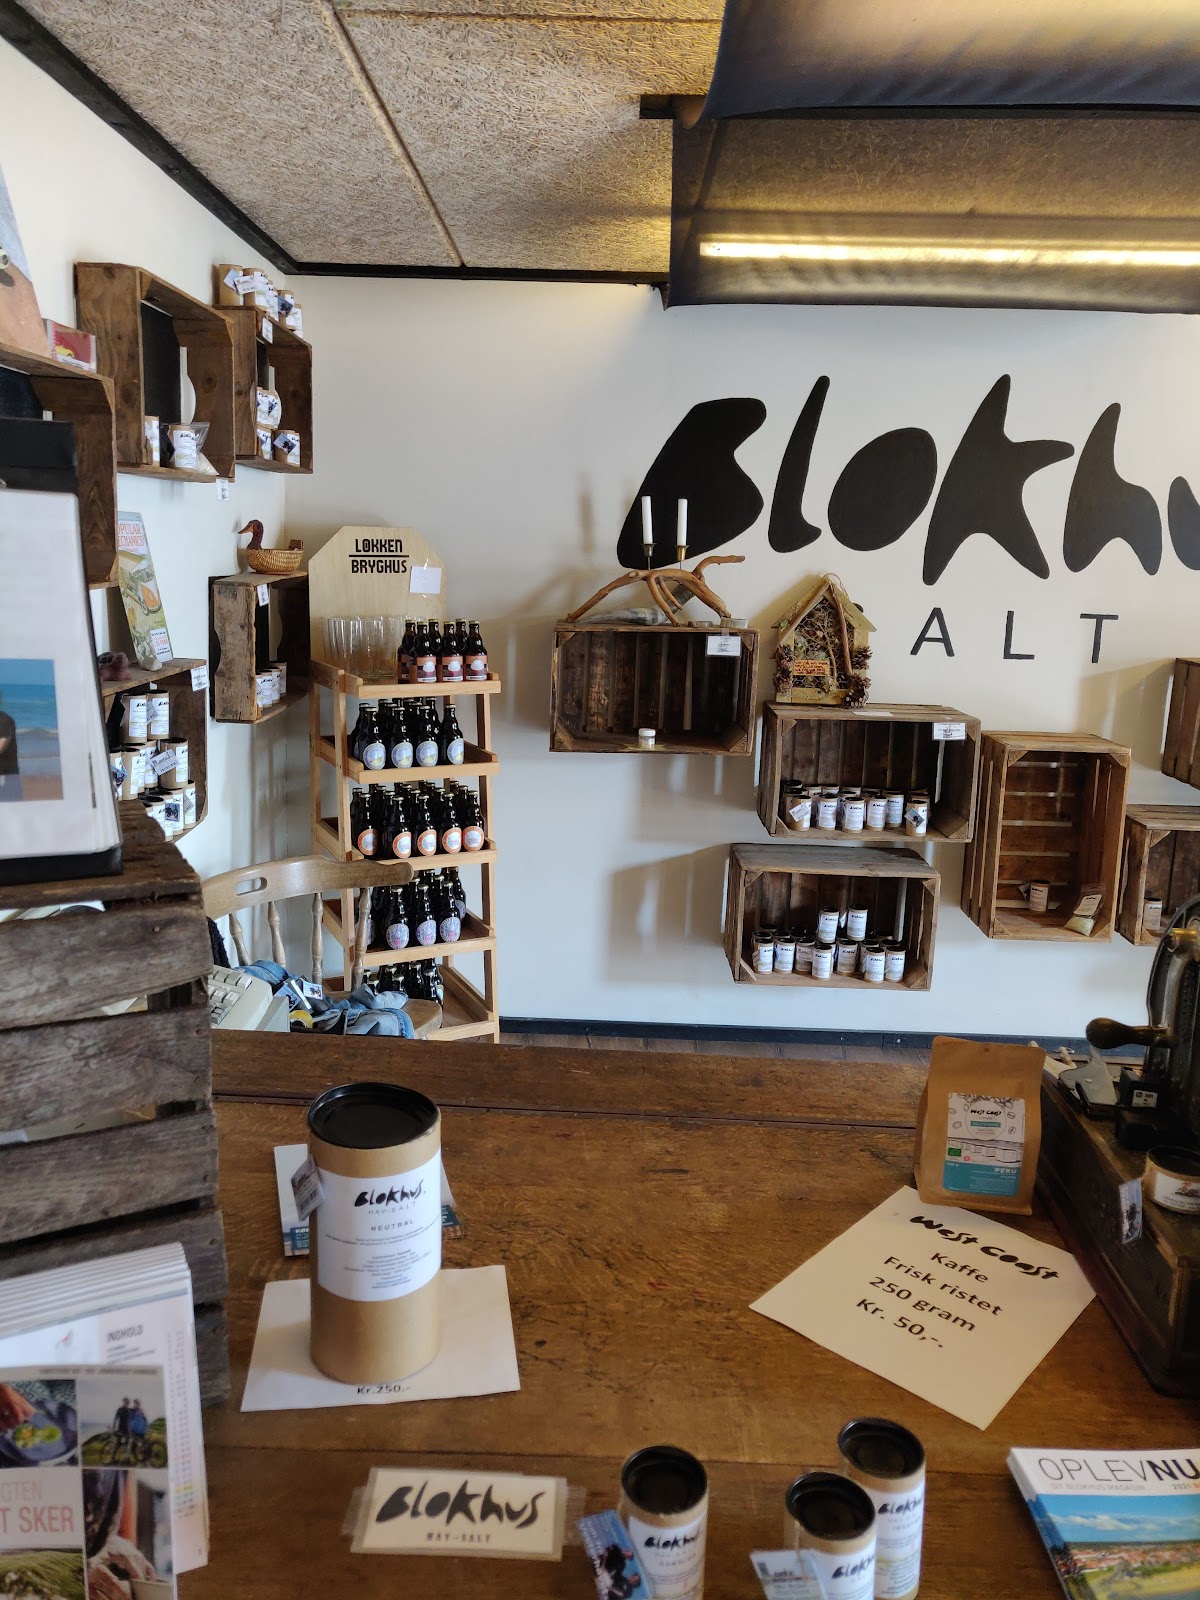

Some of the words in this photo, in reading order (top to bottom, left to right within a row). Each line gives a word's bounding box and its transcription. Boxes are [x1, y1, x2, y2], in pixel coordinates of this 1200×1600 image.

[351, 559, 408, 574] BRYGHUS
[852, 603, 1119, 664] ALT
[354, 1179, 425, 1207] Blokhus
[368, 1201, 416, 1215] HAV-SALT
[370, 1220, 414, 1231] NEUTRAL
[909, 1215, 979, 1245] West
[980, 1246, 1060, 1280] Coast
[930, 1252, 989, 1283] Kaffe
[884, 1256, 936, 1285] Frisk
[940, 1282, 1003, 1316] ristet
[856, 1298, 886, 1320] Kr.
[869, 1276, 912, 1300] 250
[912, 1299, 976, 1332] gram
[18, 1505, 75, 1534] SKER
[375, 1480, 546, 1529] Blokhus
